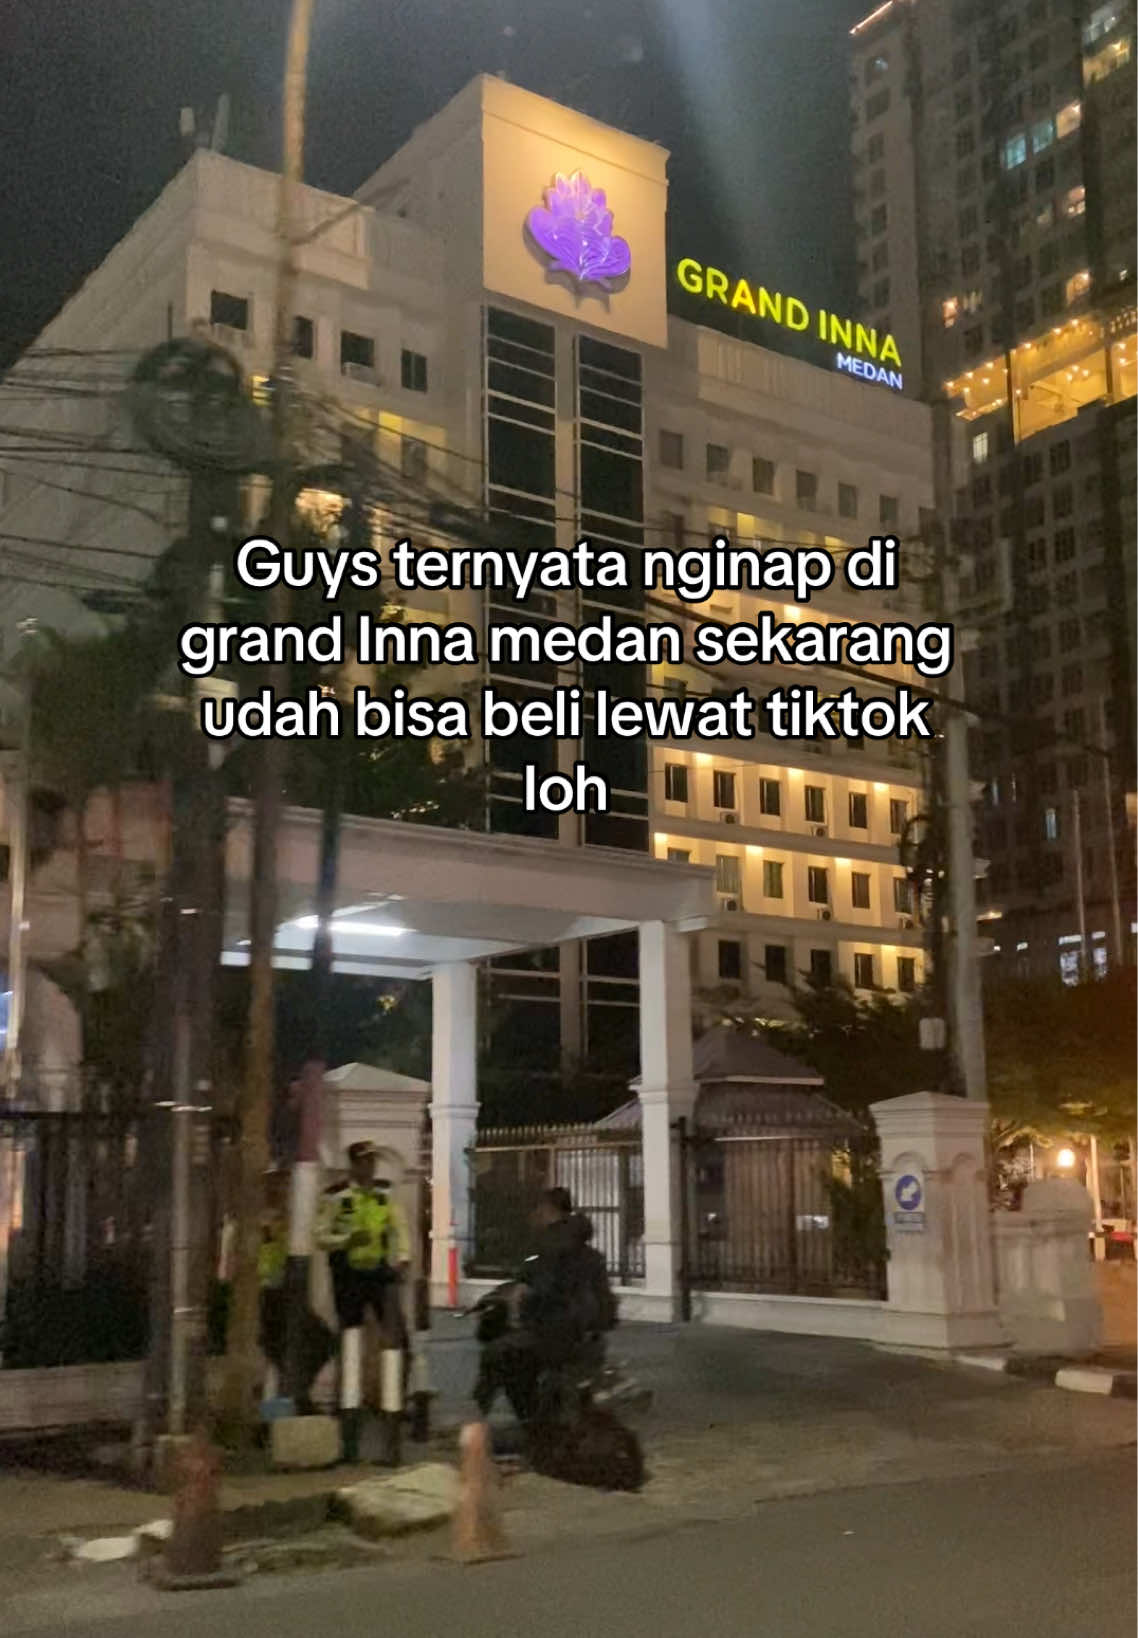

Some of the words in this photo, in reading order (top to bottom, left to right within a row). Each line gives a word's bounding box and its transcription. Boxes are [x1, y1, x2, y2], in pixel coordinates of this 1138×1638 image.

[677, 257, 810, 331] GRAND
[819, 308, 902, 367] INNA
[836, 352, 903, 390] MEDAN
